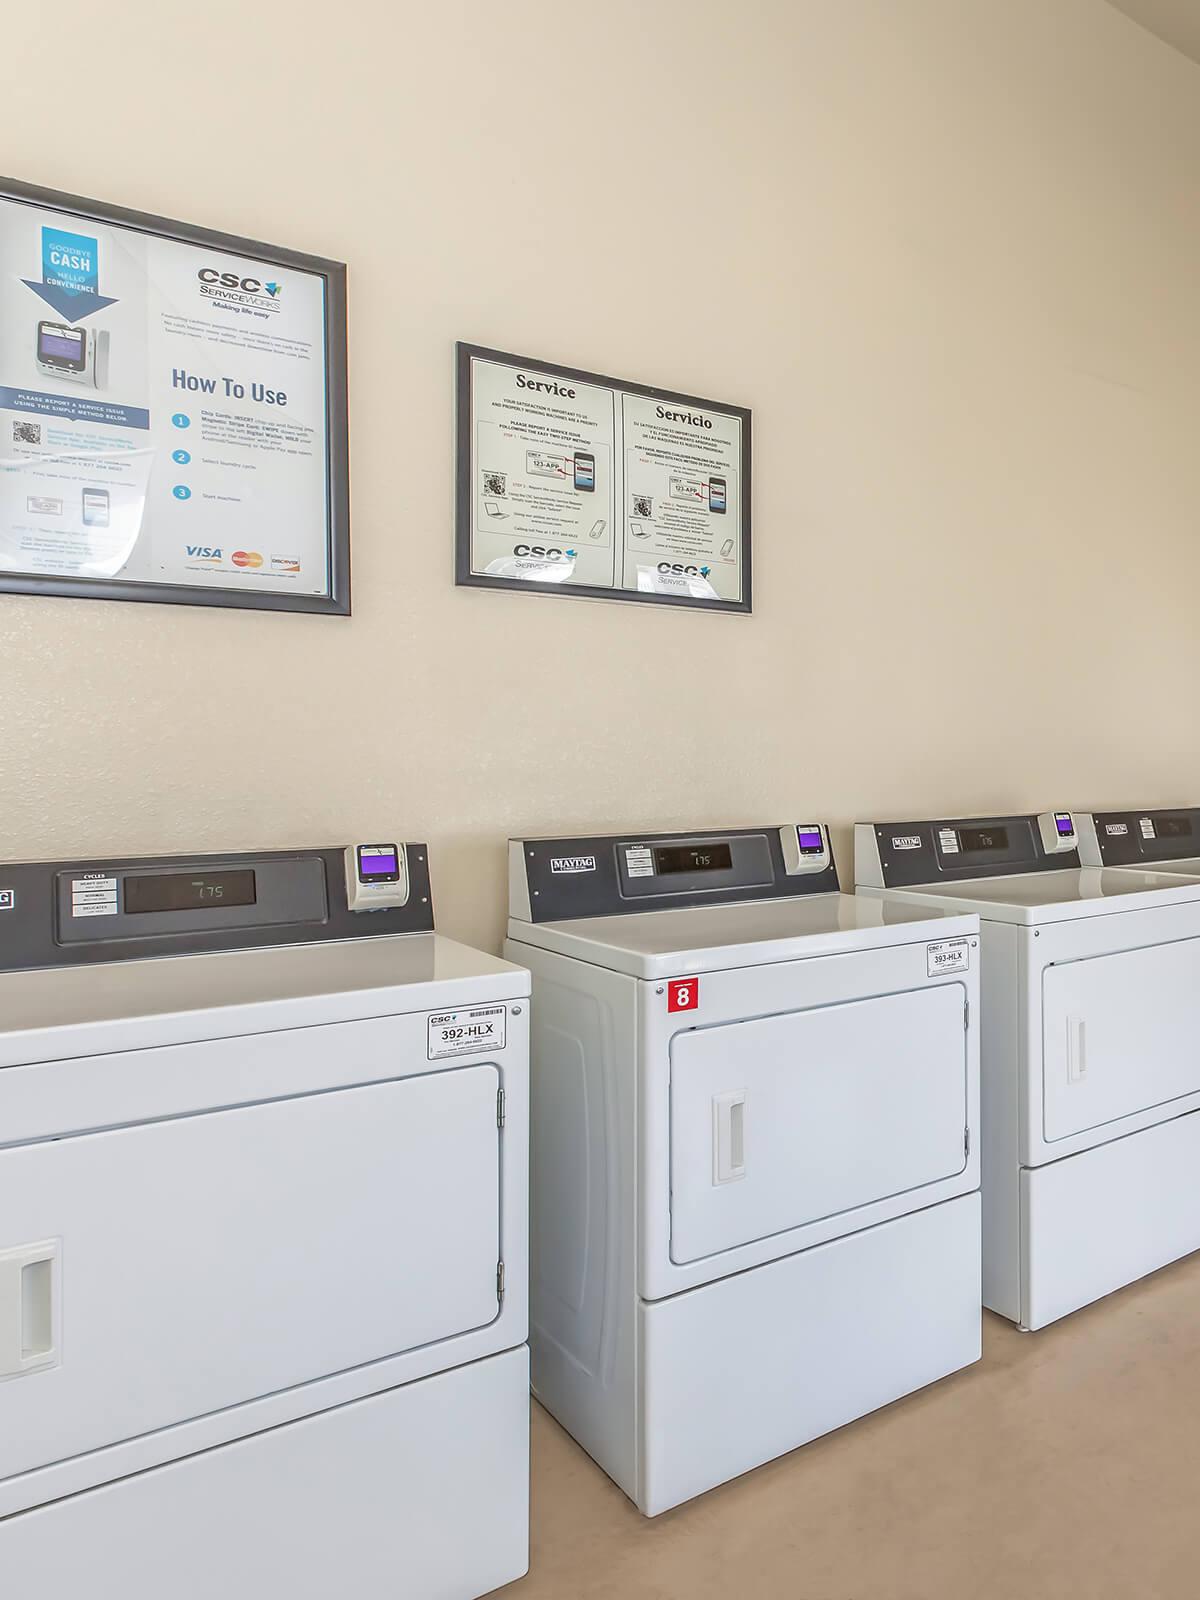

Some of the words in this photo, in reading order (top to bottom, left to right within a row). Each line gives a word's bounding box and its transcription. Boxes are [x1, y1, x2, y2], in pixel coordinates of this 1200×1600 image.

[49, 243, 91, 257] GOODBYE
[50, 252, 90, 272] CASH
[58, 272, 85, 282] HELLO
[198, 268, 261, 292] CSC
[47, 278, 95, 293] CONVENIENCE
[213, 302, 240, 313] Making
[254, 311, 270, 319] easy
[172, 368, 216, 394] How
[222, 378, 244, 399] To
[252, 383, 287, 406] Use
[516, 374, 576, 399] Service
[18, 394, 42, 402] PLEASE
[79, 404, 104, 412] SERVICE
[517, 401, 546, 410] SATISFACTION
[78, 410, 104, 418] METHOD
[178, 417, 183, 425] 1
[656, 406, 713, 429] Servicio
[499, 424, 527, 432] FOLLOWING
[178, 453, 185, 461] 2
[186, 546, 222, 558] VISA
[514, 545, 562, 560] CSC
[658, 562, 697, 576] CSC
[554, 859, 592, 868] MAYTAG
[935, 952, 962, 963] 393-HLX
[677, 988, 689, 1006] 8
[442, 1024, 493, 1040] 392-HLX
